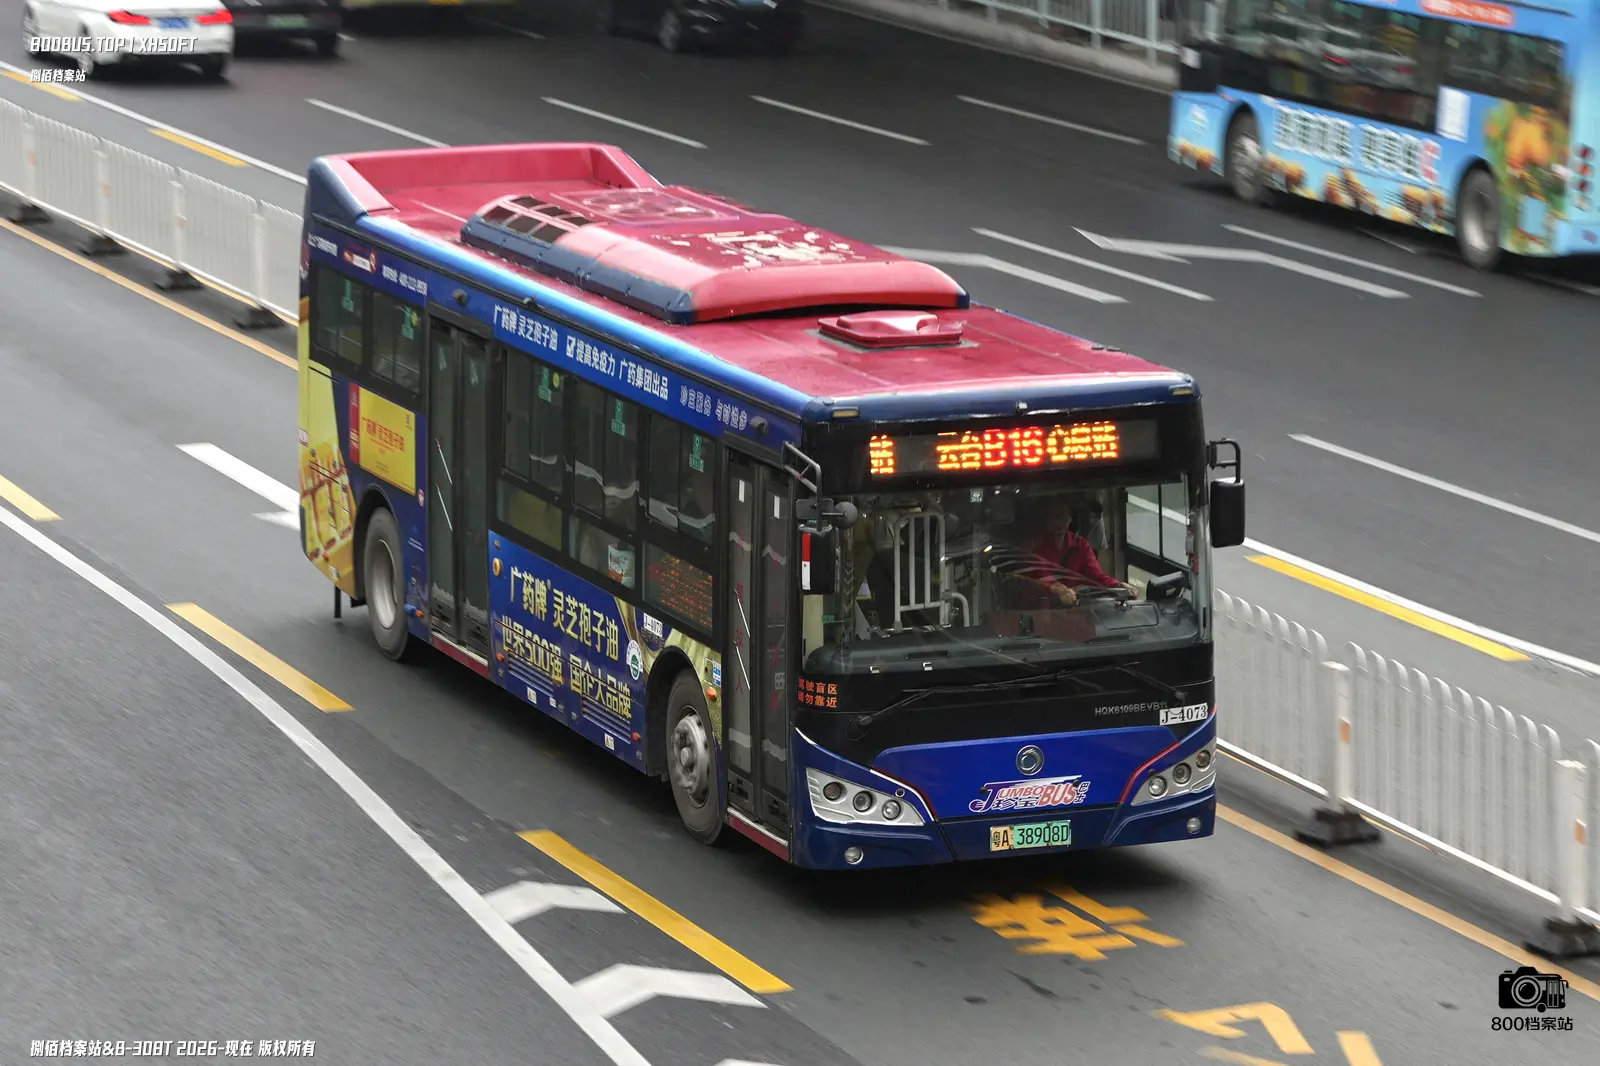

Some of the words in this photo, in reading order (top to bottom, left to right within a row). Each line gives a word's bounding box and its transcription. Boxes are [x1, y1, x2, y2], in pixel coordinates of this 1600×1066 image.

[575, 341, 617, 378] 提高免疫力
[619, 357, 669, 401] 广药集团出品
[509, 566, 549, 623] 广药牌
[552, 587, 619, 662] 灵芝孢子油
[501, 614, 564, 685] 世界500强
[569, 652, 632, 721] 国企大品牌
[797, 690, 838, 708] 请勿靠近
[1161, 705, 1208, 724] J-4073
